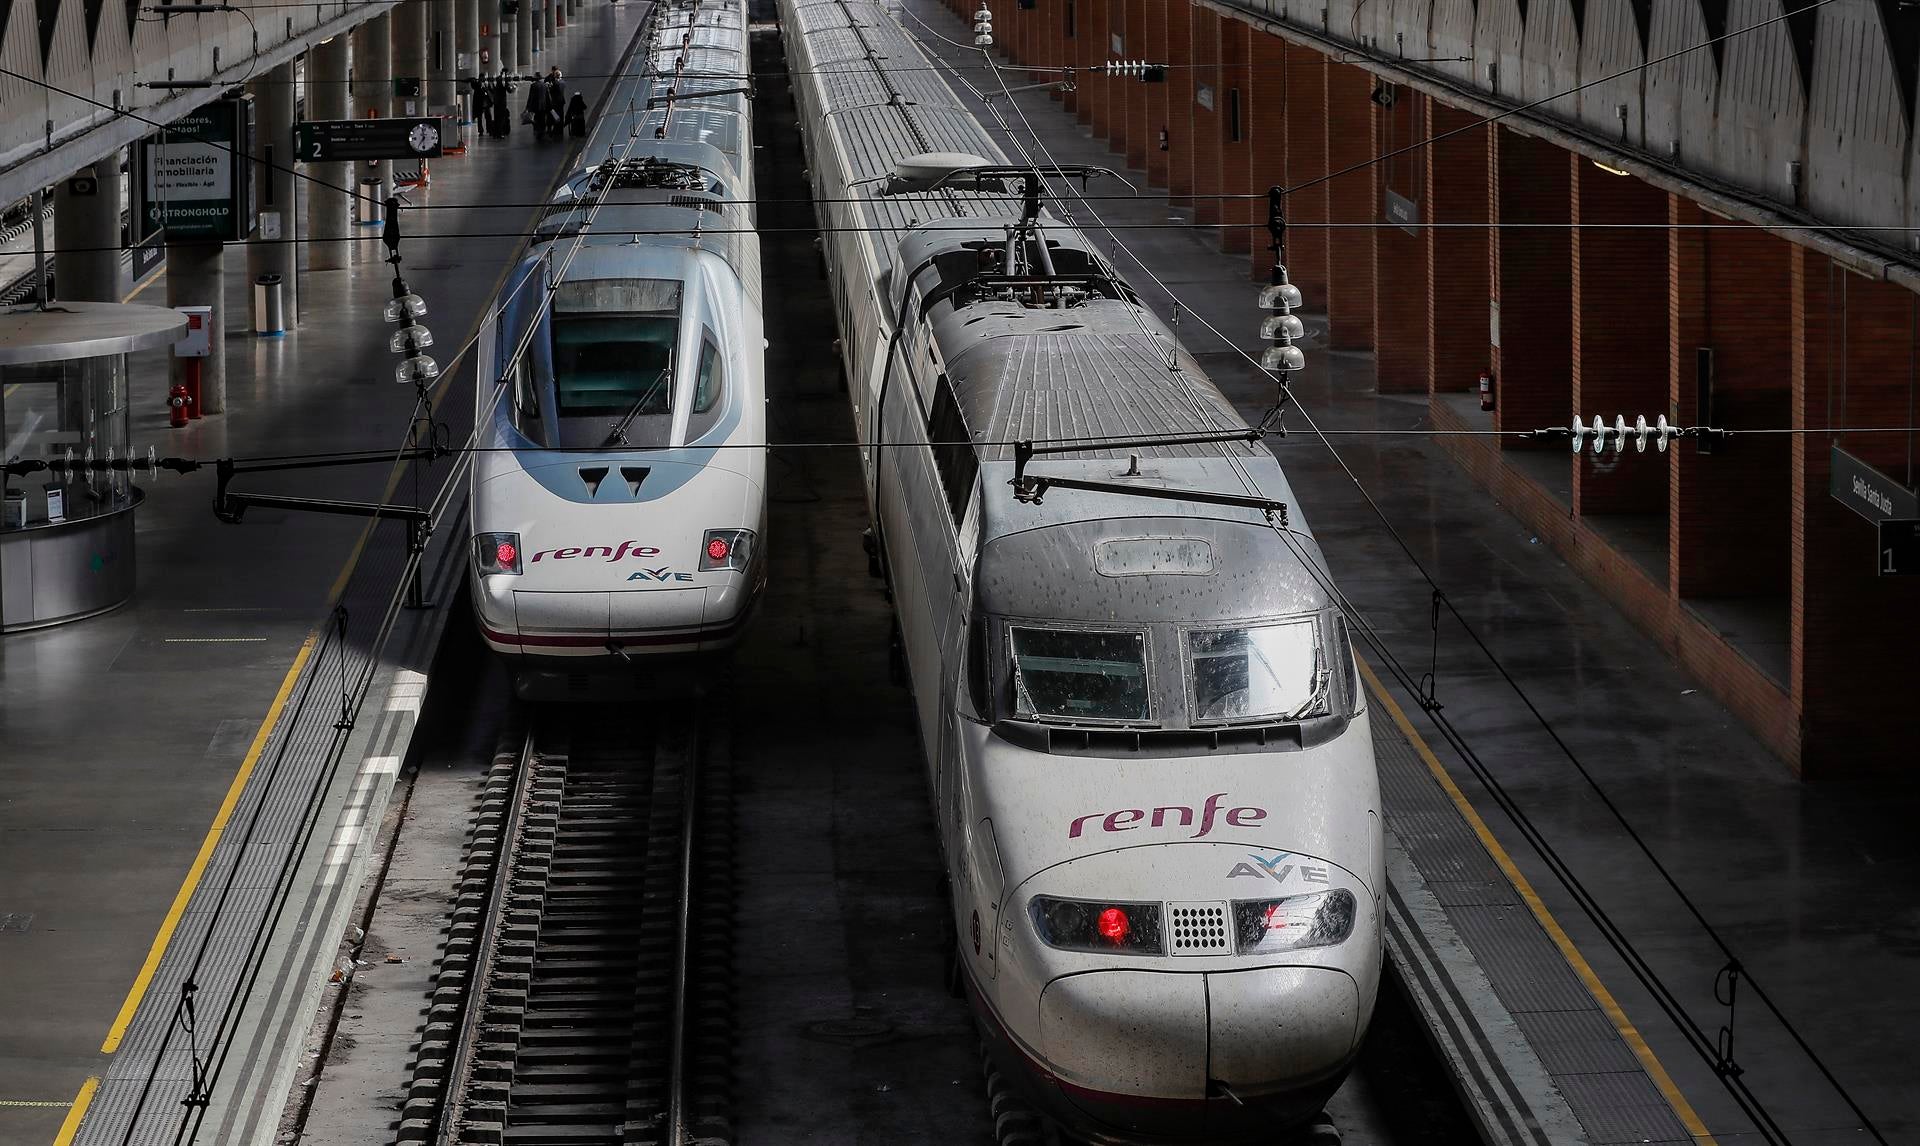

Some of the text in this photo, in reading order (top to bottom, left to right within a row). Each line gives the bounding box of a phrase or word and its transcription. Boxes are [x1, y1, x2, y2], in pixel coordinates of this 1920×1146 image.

[412, 86, 419, 96] 2
[312, 142, 322, 158] 2
[162, 207, 229, 217] STRONGHOLD
[531, 540, 661, 563] renfe
[1882, 547, 1897, 573] 1
[626, 567, 694, 582] AVE
[1068, 792, 1268, 839] renfe
[1225, 854, 1329, 885] AVE
